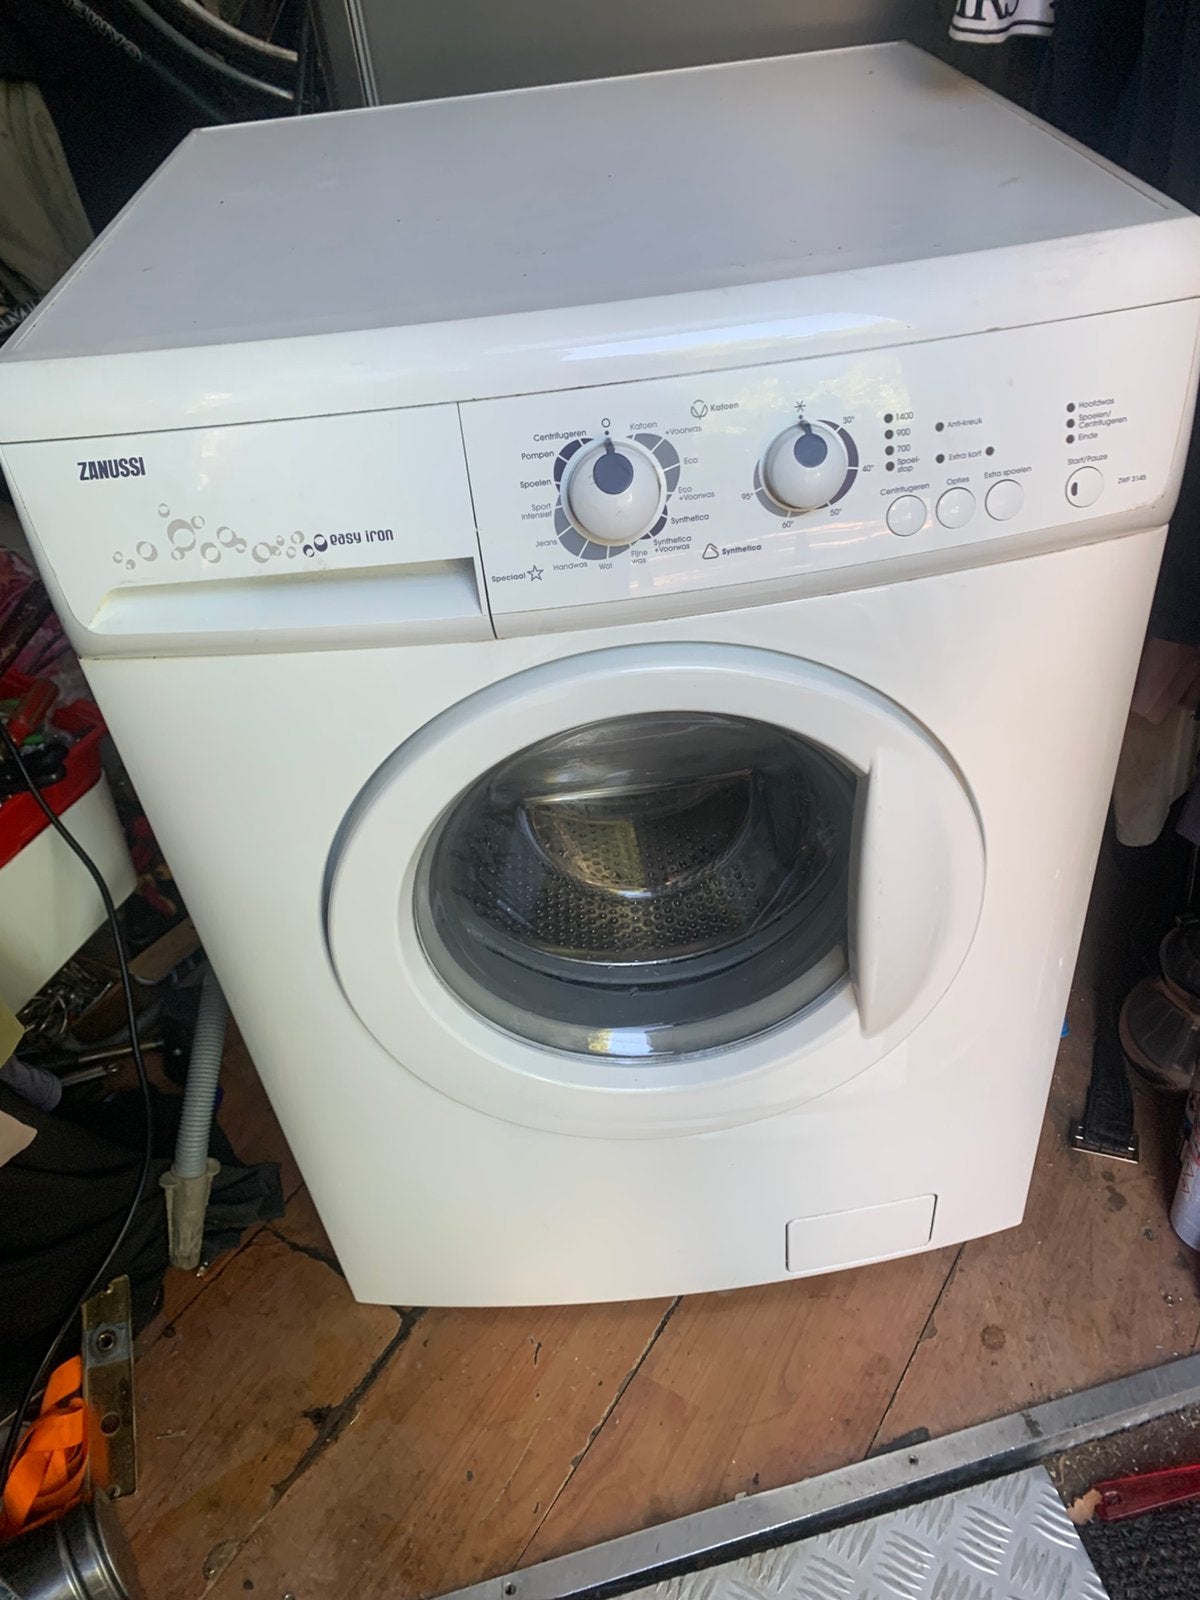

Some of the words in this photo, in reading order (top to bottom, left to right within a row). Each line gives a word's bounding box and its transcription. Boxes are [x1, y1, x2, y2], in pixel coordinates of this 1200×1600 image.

[710, 402, 739, 412] Katoen
[842, 416, 855, 425] 30°
[895, 411, 914, 421] 1400
[629, 421, 658, 431] Katoen
[947, 417, 983, 429] Anti-kreuk
[1078, 416, 1128, 429] Centrifugeren
[533, 430, 587, 441] Centrifugeren
[665, 425, 702, 436] +Voorwas
[896, 428, 911, 437] 900
[1078, 432, 1098, 441] Einde
[897, 444, 911, 453] 700
[521, 450, 555, 461] Pompen
[948, 453, 967, 461] Extra
[968, 450, 983, 458] kort
[683, 457, 699, 465] Eco
[897, 456, 920, 466] Spoel-
[77, 456, 147, 481] ZANUSSI
[862, 465, 874, 473] 40°
[897, 466, 914, 474] stop
[984, 471, 1002, 479] Extra
[1003, 466, 1032, 477] spoelen
[519, 479, 552, 489] Spoelen
[946, 477, 970, 487] Opties
[678, 486, 693, 494] Eco
[880, 483, 930, 496] Centrifugeren
[679, 491, 716, 501] +Voorwas
[741, 492, 754, 500] 95°
[531, 503, 552, 512] Sport
[830, 508, 842, 516] 50°
[671, 513, 710, 524] Synthetica
[782, 521, 794, 529] 60°
[329, 531, 362, 546] easy
[365, 529, 394, 542] iron
[653, 536, 692, 546] Synthetica
[535, 540, 558, 548] Jeans
[654, 543, 690, 553] +Voorwas
[630, 550, 649, 558] Fijne
[722, 545, 762, 555] Synthetica
[553, 561, 588, 571] Handwas
[598, 562, 613, 570] Wol
[491, 572, 527, 583] Speciaal
